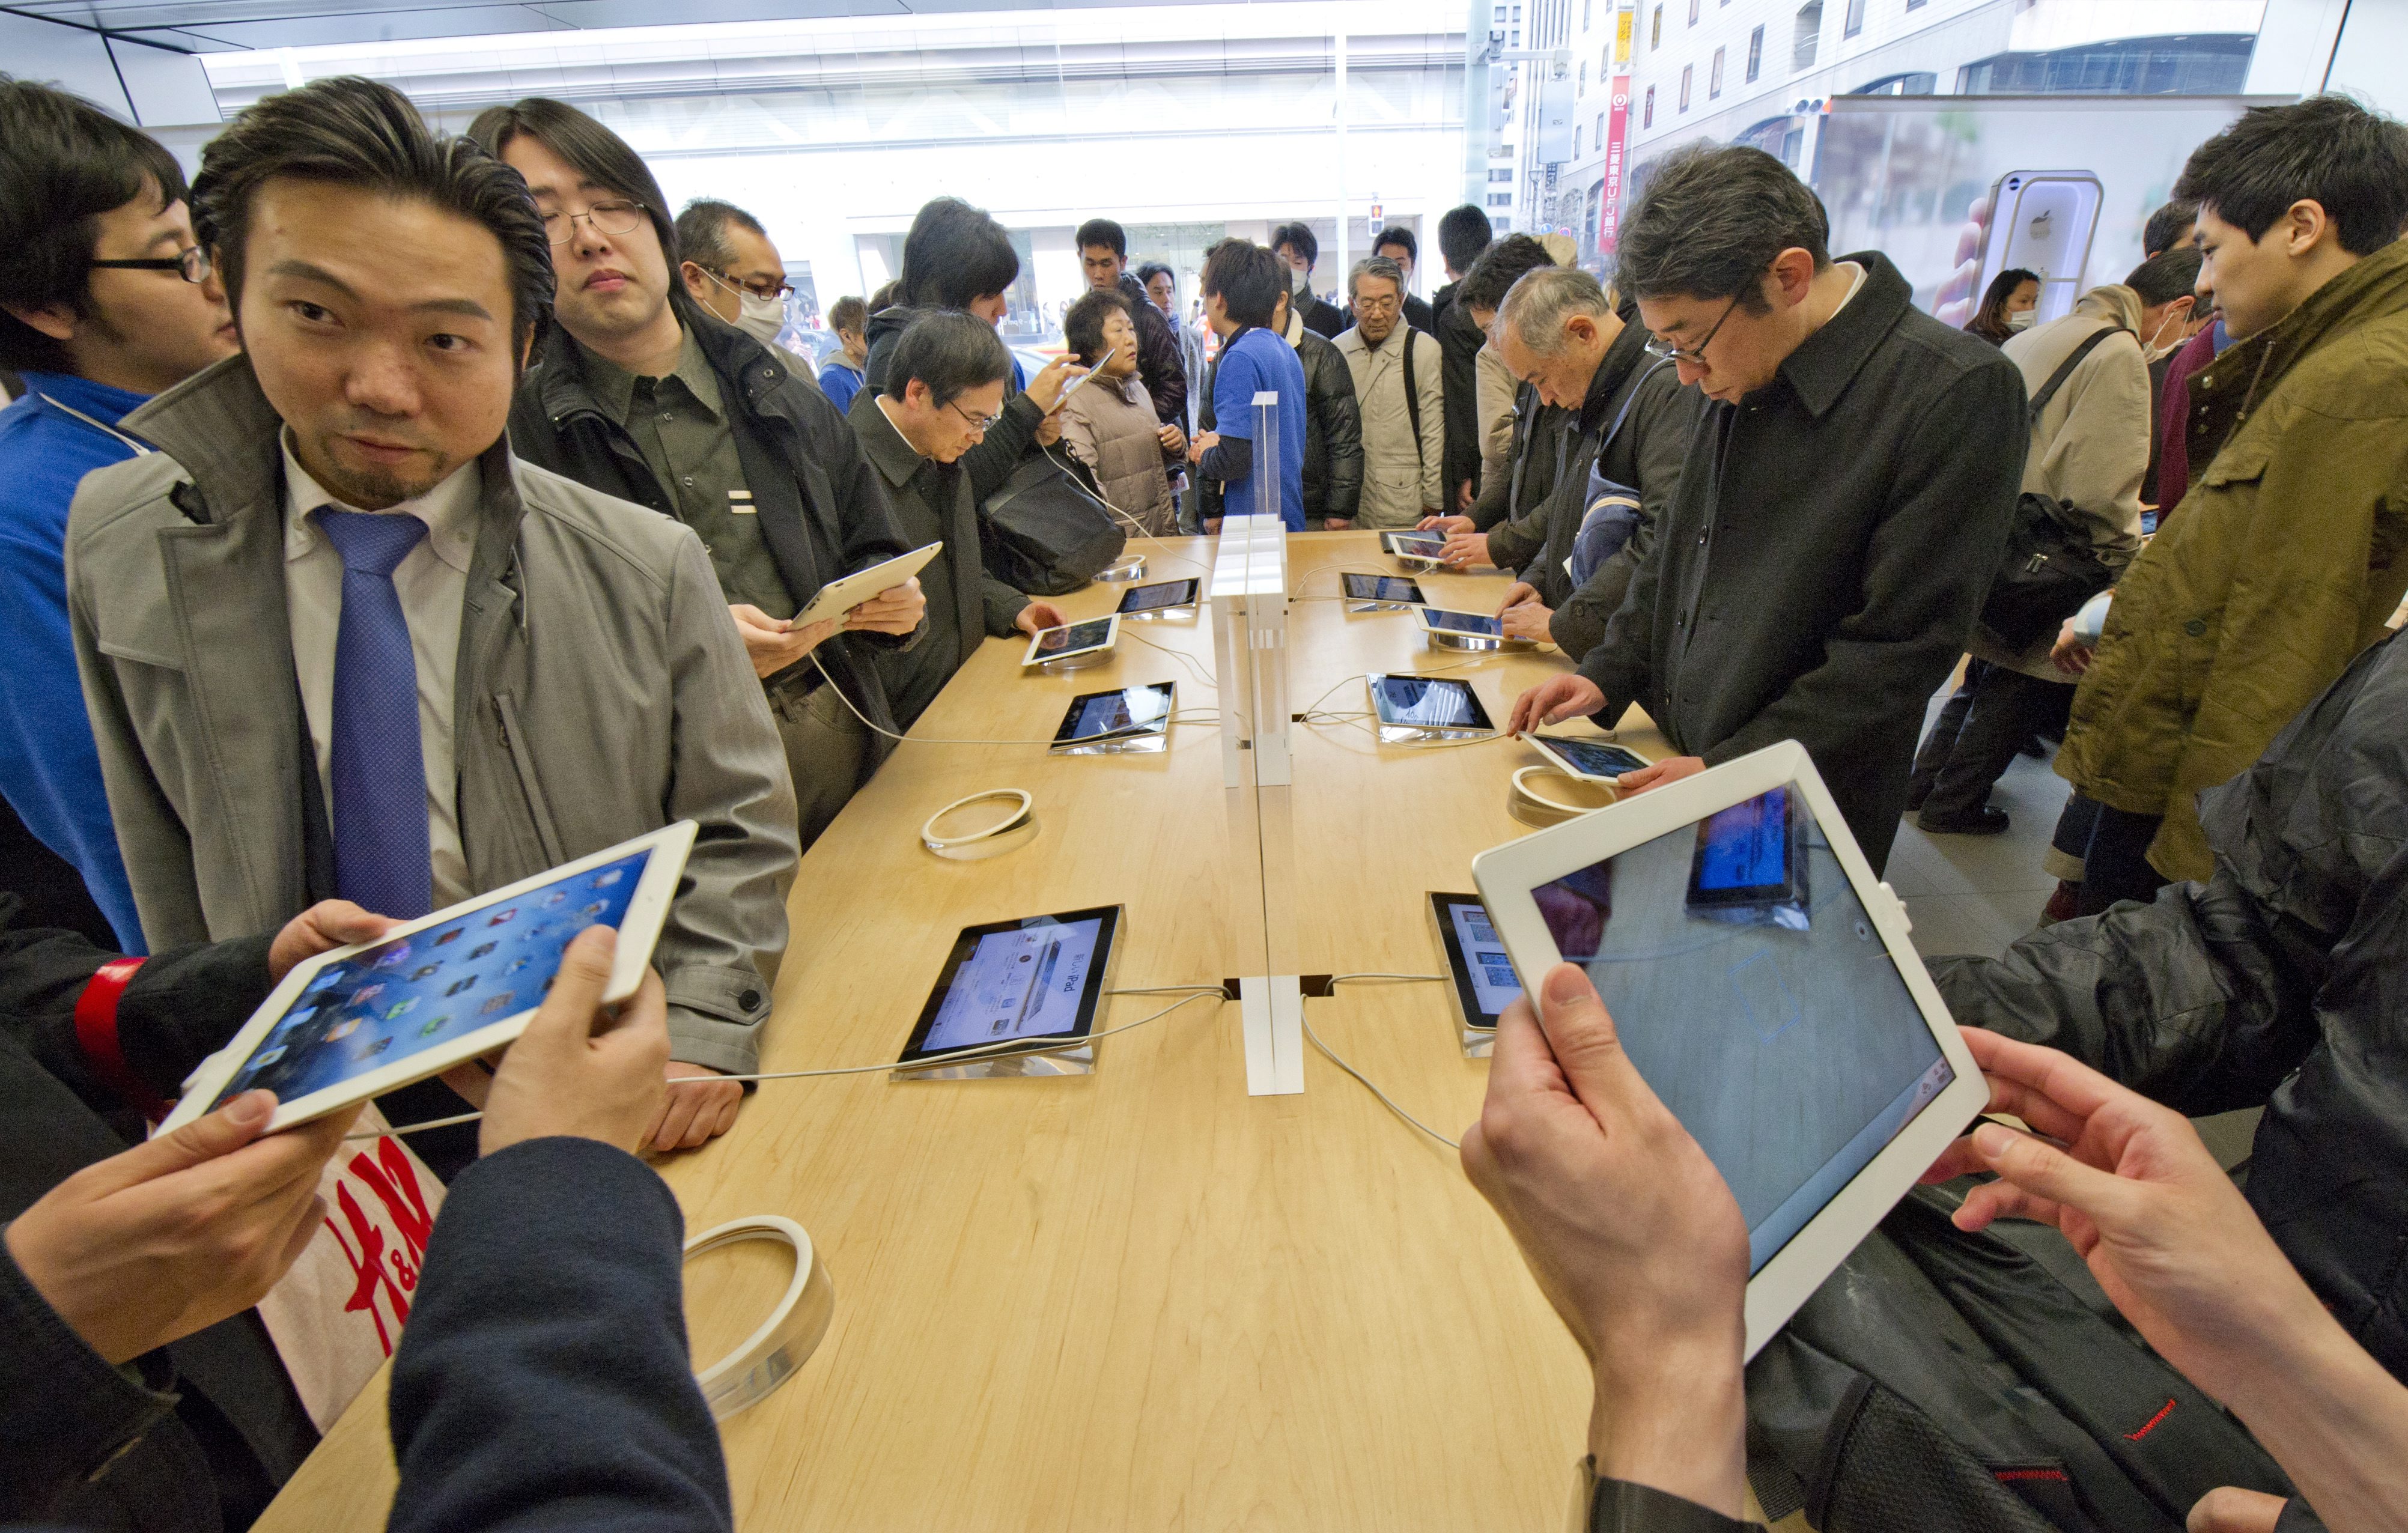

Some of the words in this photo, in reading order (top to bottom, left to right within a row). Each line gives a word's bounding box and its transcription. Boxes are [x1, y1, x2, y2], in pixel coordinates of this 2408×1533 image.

[1604, 142, 1622, 238] 三菱東京UFJ銀行
[1071, 953, 1085, 974] 新しい
[1063, 974, 1080, 992] iPad
